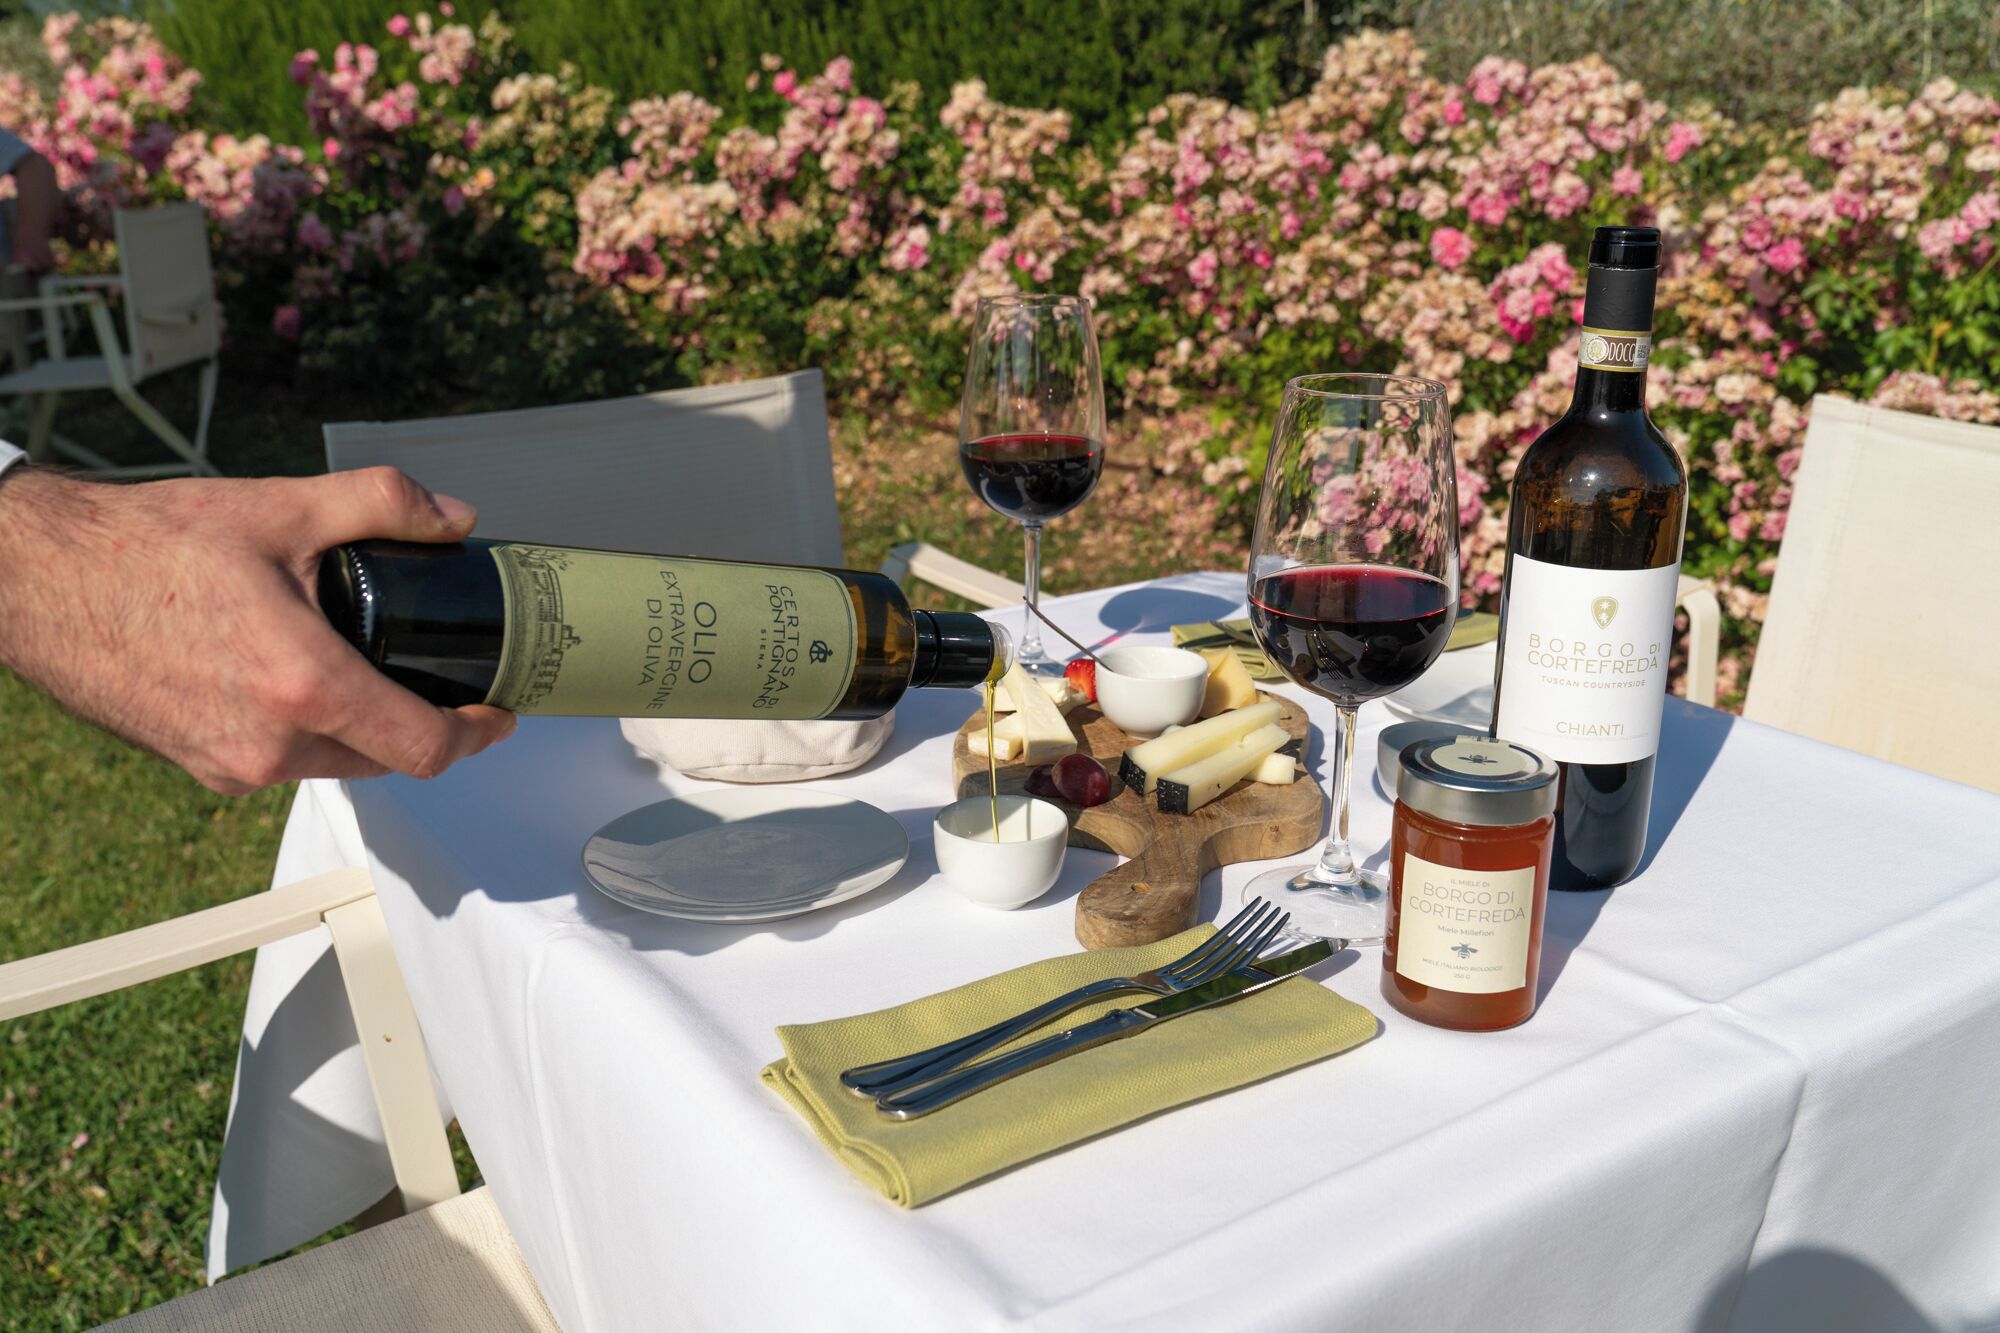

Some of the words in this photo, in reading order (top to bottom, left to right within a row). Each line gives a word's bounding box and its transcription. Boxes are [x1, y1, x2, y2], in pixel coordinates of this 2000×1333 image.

[647, 599, 663, 618] DI
[646, 571, 685, 710] EXTRAVERGINE
[688, 602, 717, 683] OLIO
[753, 585, 785, 708] PONTIGNANO
[757, 629, 767, 669] SIENA
[780, 586, 799, 692] CERTOSA
[1529, 633, 1634, 658] BORGO
[638, 626, 663, 686] OLIVA
[1527, 650, 1658, 674] CORTEFREDA
[1542, 675, 1579, 687] TUSCAN
[1583, 680, 1646, 689] COUNTRYSIDE
[765, 698, 779, 708] DI
[1556, 721, 1624, 737] CHIANTI
[1423, 882, 1492, 905] BORGO
[1497, 891, 1514, 905] DI
[1409, 896, 1526, 923] CORTEFREDA
[1438, 925, 1459, 935] Miele
[1461, 928, 1495, 937] Millefiori
